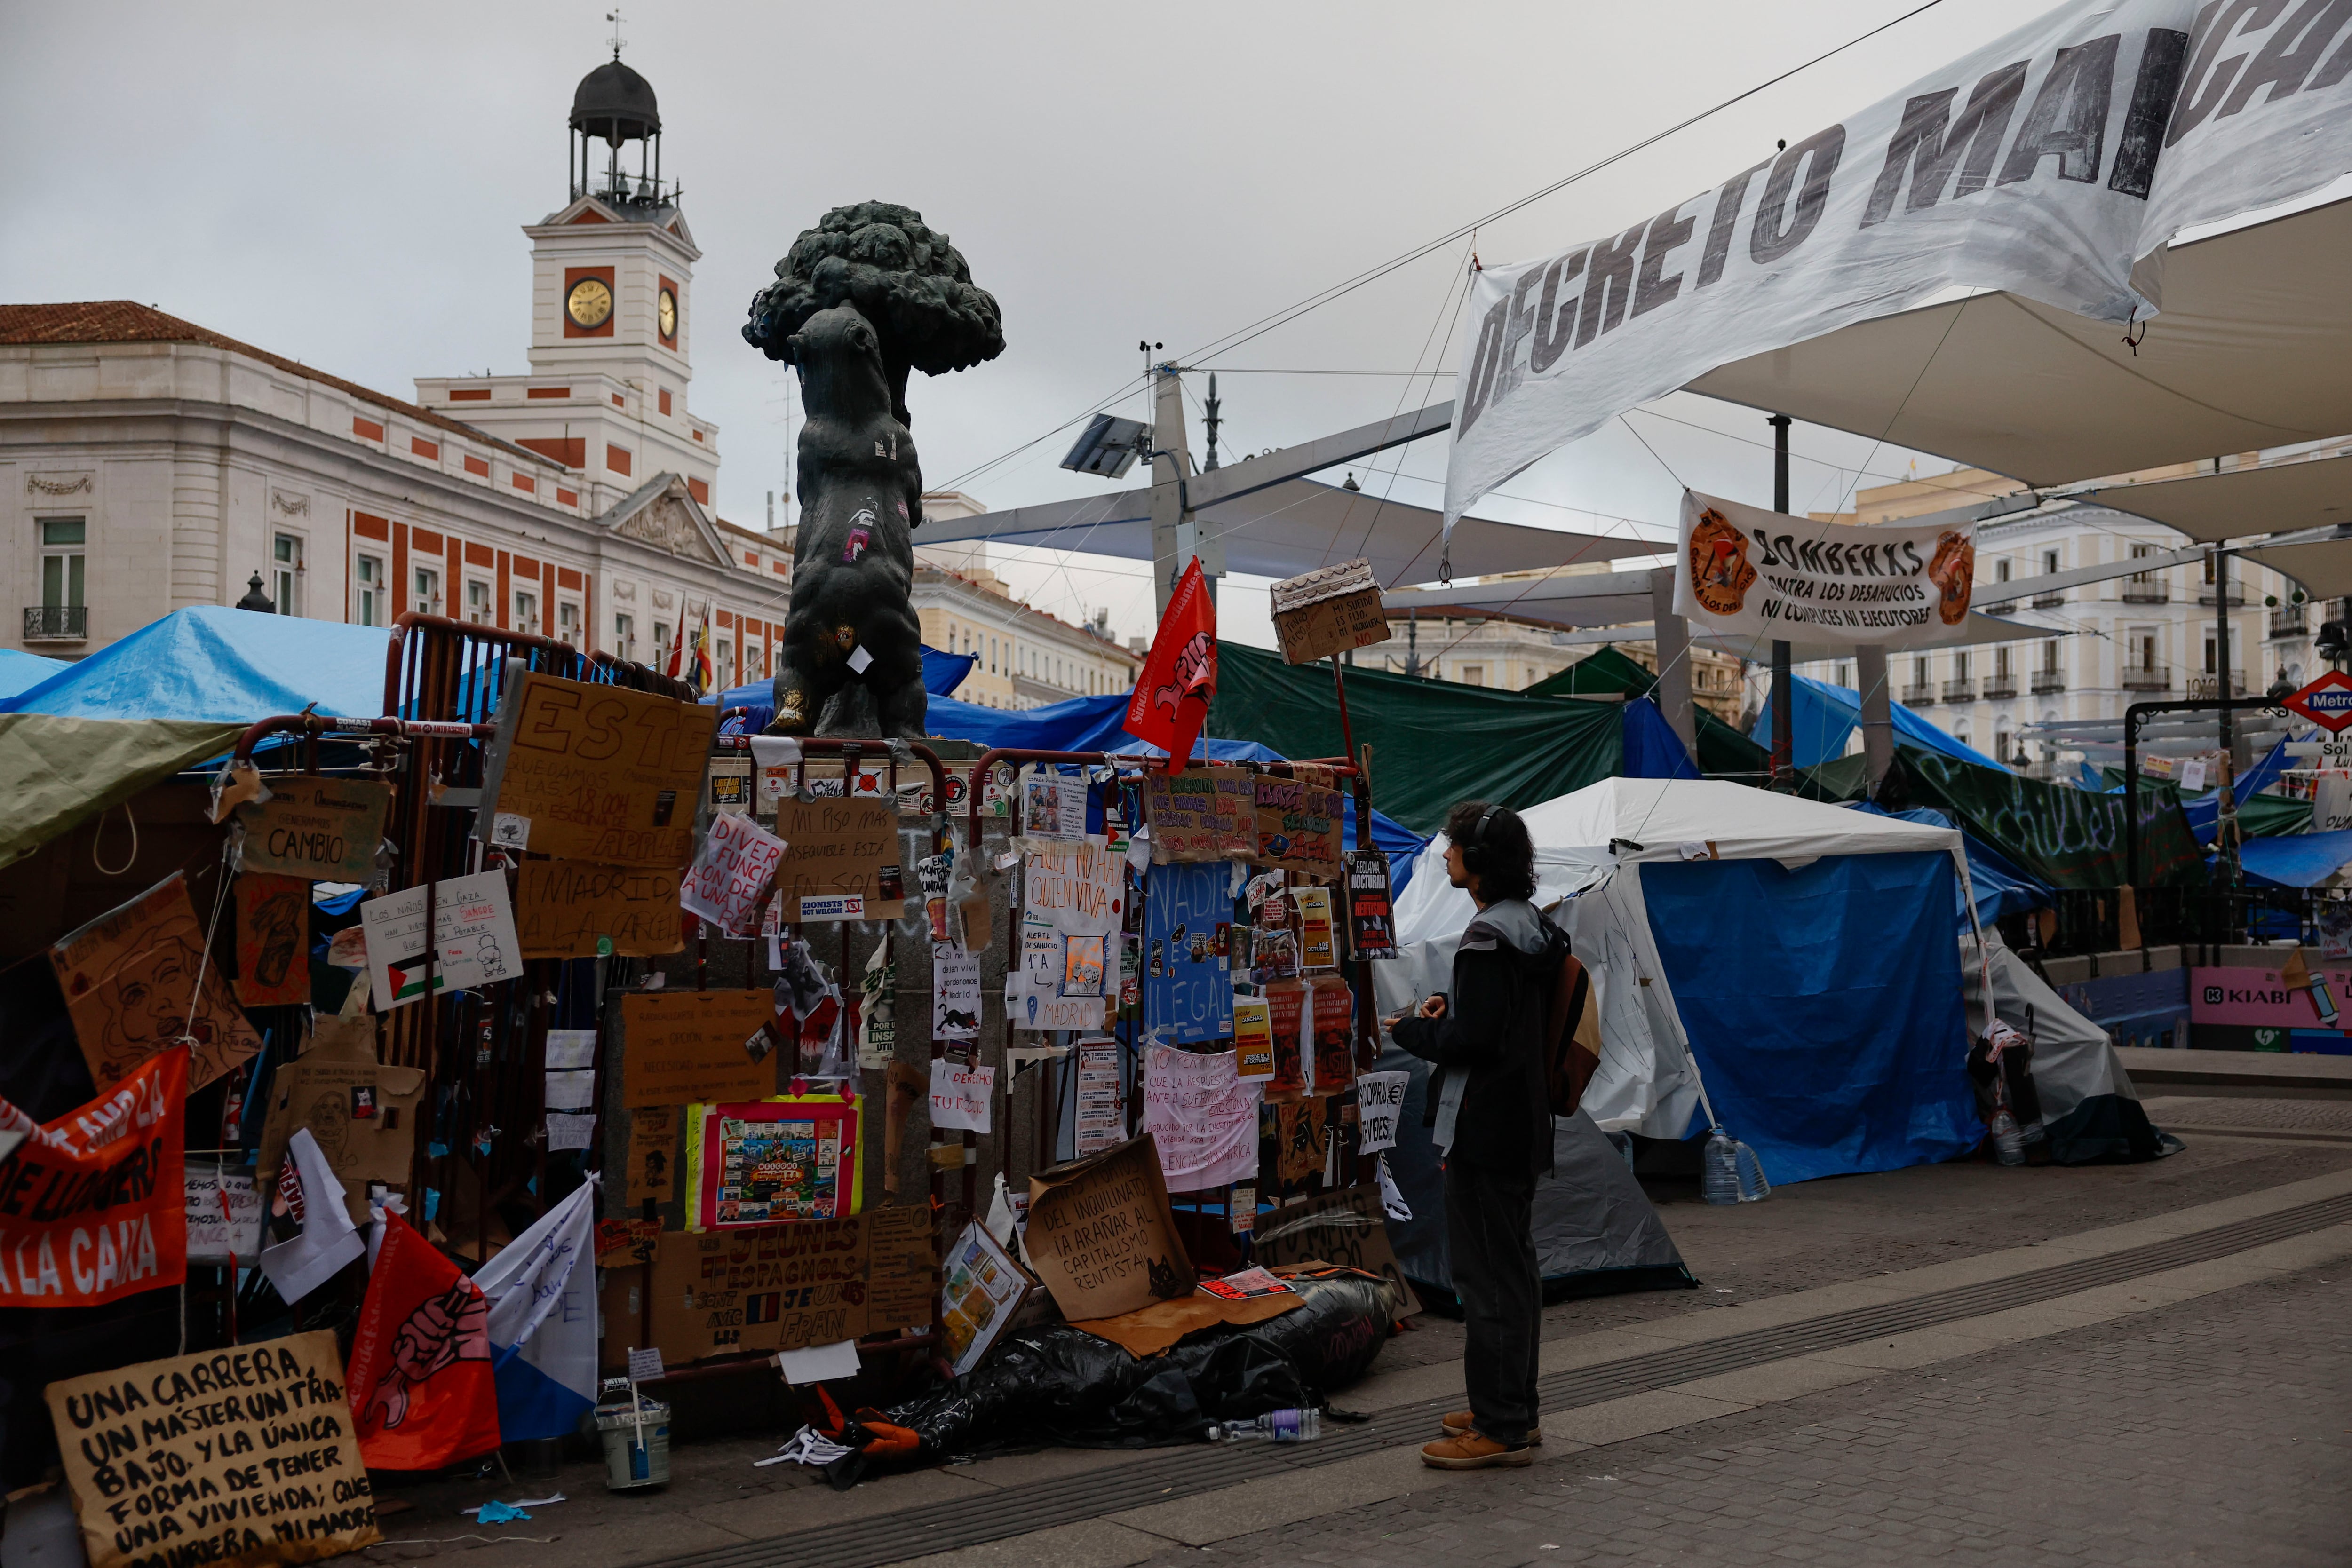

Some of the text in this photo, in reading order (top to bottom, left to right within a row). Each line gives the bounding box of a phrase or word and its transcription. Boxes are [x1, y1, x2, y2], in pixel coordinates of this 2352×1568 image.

[1457, 122, 1846, 441] DECRETO
[1754, 529, 1923, 577] BOMBERXS
[1820, 582, 1925, 602] LOS DESAHUCIOS
[1332, 604, 1343, 614] MI
[1761, 599, 1931, 627] NI CÓMPLICES NI EJECUTORES
[1285, 612, 1308, 633] TENGO
[1335, 616, 1345, 626] ES
[1339, 617, 1382, 637] MI ALQUILER
[1130, 568, 1202, 725] Sindicato Estudiantes
[1355, 632, 1371, 647] NO
[409, 724, 469, 736] ZONA ANTIFASCISTA
[513, 681, 714, 773] ESTE
[2323, 744, 2348, 755] Sol
[506, 752, 610, 789] QUEDAMOS
[501, 771, 595, 814] A 18
[715, 778, 739, 787] LIBERAR
[716, 786, 739, 795] MADRID
[953, 787, 960, 799] 7
[1150, 775, 1216, 794] ME ENCANTA
[497, 793, 521, 811] EN
[529, 802, 544, 816] LA
[612, 815, 627, 827] DE
[1215, 796, 1237, 815] ODIO
[790, 807, 888, 834] MI PISO MÁS
[1237, 816, 1254, 833] NO
[1282, 813, 1301, 832] DE
[268, 828, 343, 864] CAMBIO
[592, 828, 693, 859] APPLE
[786, 838, 888, 863] ASEQUIBLE ESTÁ
[1190, 834, 1215, 850] OTRA
[1077, 844, 1125, 887] NO HAY
[1356, 861, 1380, 874] RECLAMA
[793, 872, 877, 901] EN SOL
[1351, 874, 1386, 889] NOCTURNA
[435, 898, 447, 906] EN
[457, 891, 480, 903] GAZA
[683, 878, 729, 910] A UNA
[1031, 876, 1071, 908] QUIEN
[1076, 880, 1108, 919] VIVA
[1149, 863, 1232, 939] NADIE
[384, 904, 495, 938] HAN VISTO SANGRE
[523, 911, 605, 941] A LA
[403, 940, 418, 950] QUE
[1027, 931, 1050, 939] ALERTA
[1041, 954, 1049, 969] A
[949, 990, 970, 999] Madrid
[1148, 975, 1233, 1033] ILEGAL
[2229, 990, 2291, 1004] KIABI
[639, 1011, 695, 1022] RADICALIZARSE
[730, 1008, 762, 1017] PRESENTA
[1043, 1003, 1092, 1027] MADRID
[644, 1038, 664, 1046] COMO
[877, 1042, 893, 1051] ÚTIL
[644, 1060, 694, 1073] NECESIDAD
[1151, 1049, 1171, 1070] NO
[954, 1073, 992, 1085] DERECHO
[1149, 1073, 1228, 1088] QUE LA RESPUESTA
[932, 1095, 951, 1109] TU
[1146, 1091, 1169, 1103] ANTE
[1182, 1086, 1237, 1106] SUFRIMIENTO
[1183, 1123, 1206, 1133] POR LA
[1043, 1177, 1151, 1232] DEL INQUILINATO:
[698, 1219, 859, 1264] LES JEUNES
[1055, 1205, 1154, 1257] ¡A ARAÑAR AL
[15, 1229, 62, 1296] LA
[1063, 1229, 1148, 1274] CAPITALISMO
[728, 1255, 856, 1289] ESPAGNOLS
[696, 1280, 866, 1310] SONT JEUNES
[66, 1380, 149, 1429] UNA
[80, 1389, 289, 1468] UN UN
[194, 1415, 342, 1464] Y LA ÚNICA
[104, 1445, 343, 1526] FORMA DE TENER
[115, 1476, 373, 1554] UNA QUE
[271, 1519, 308, 1544] MI
